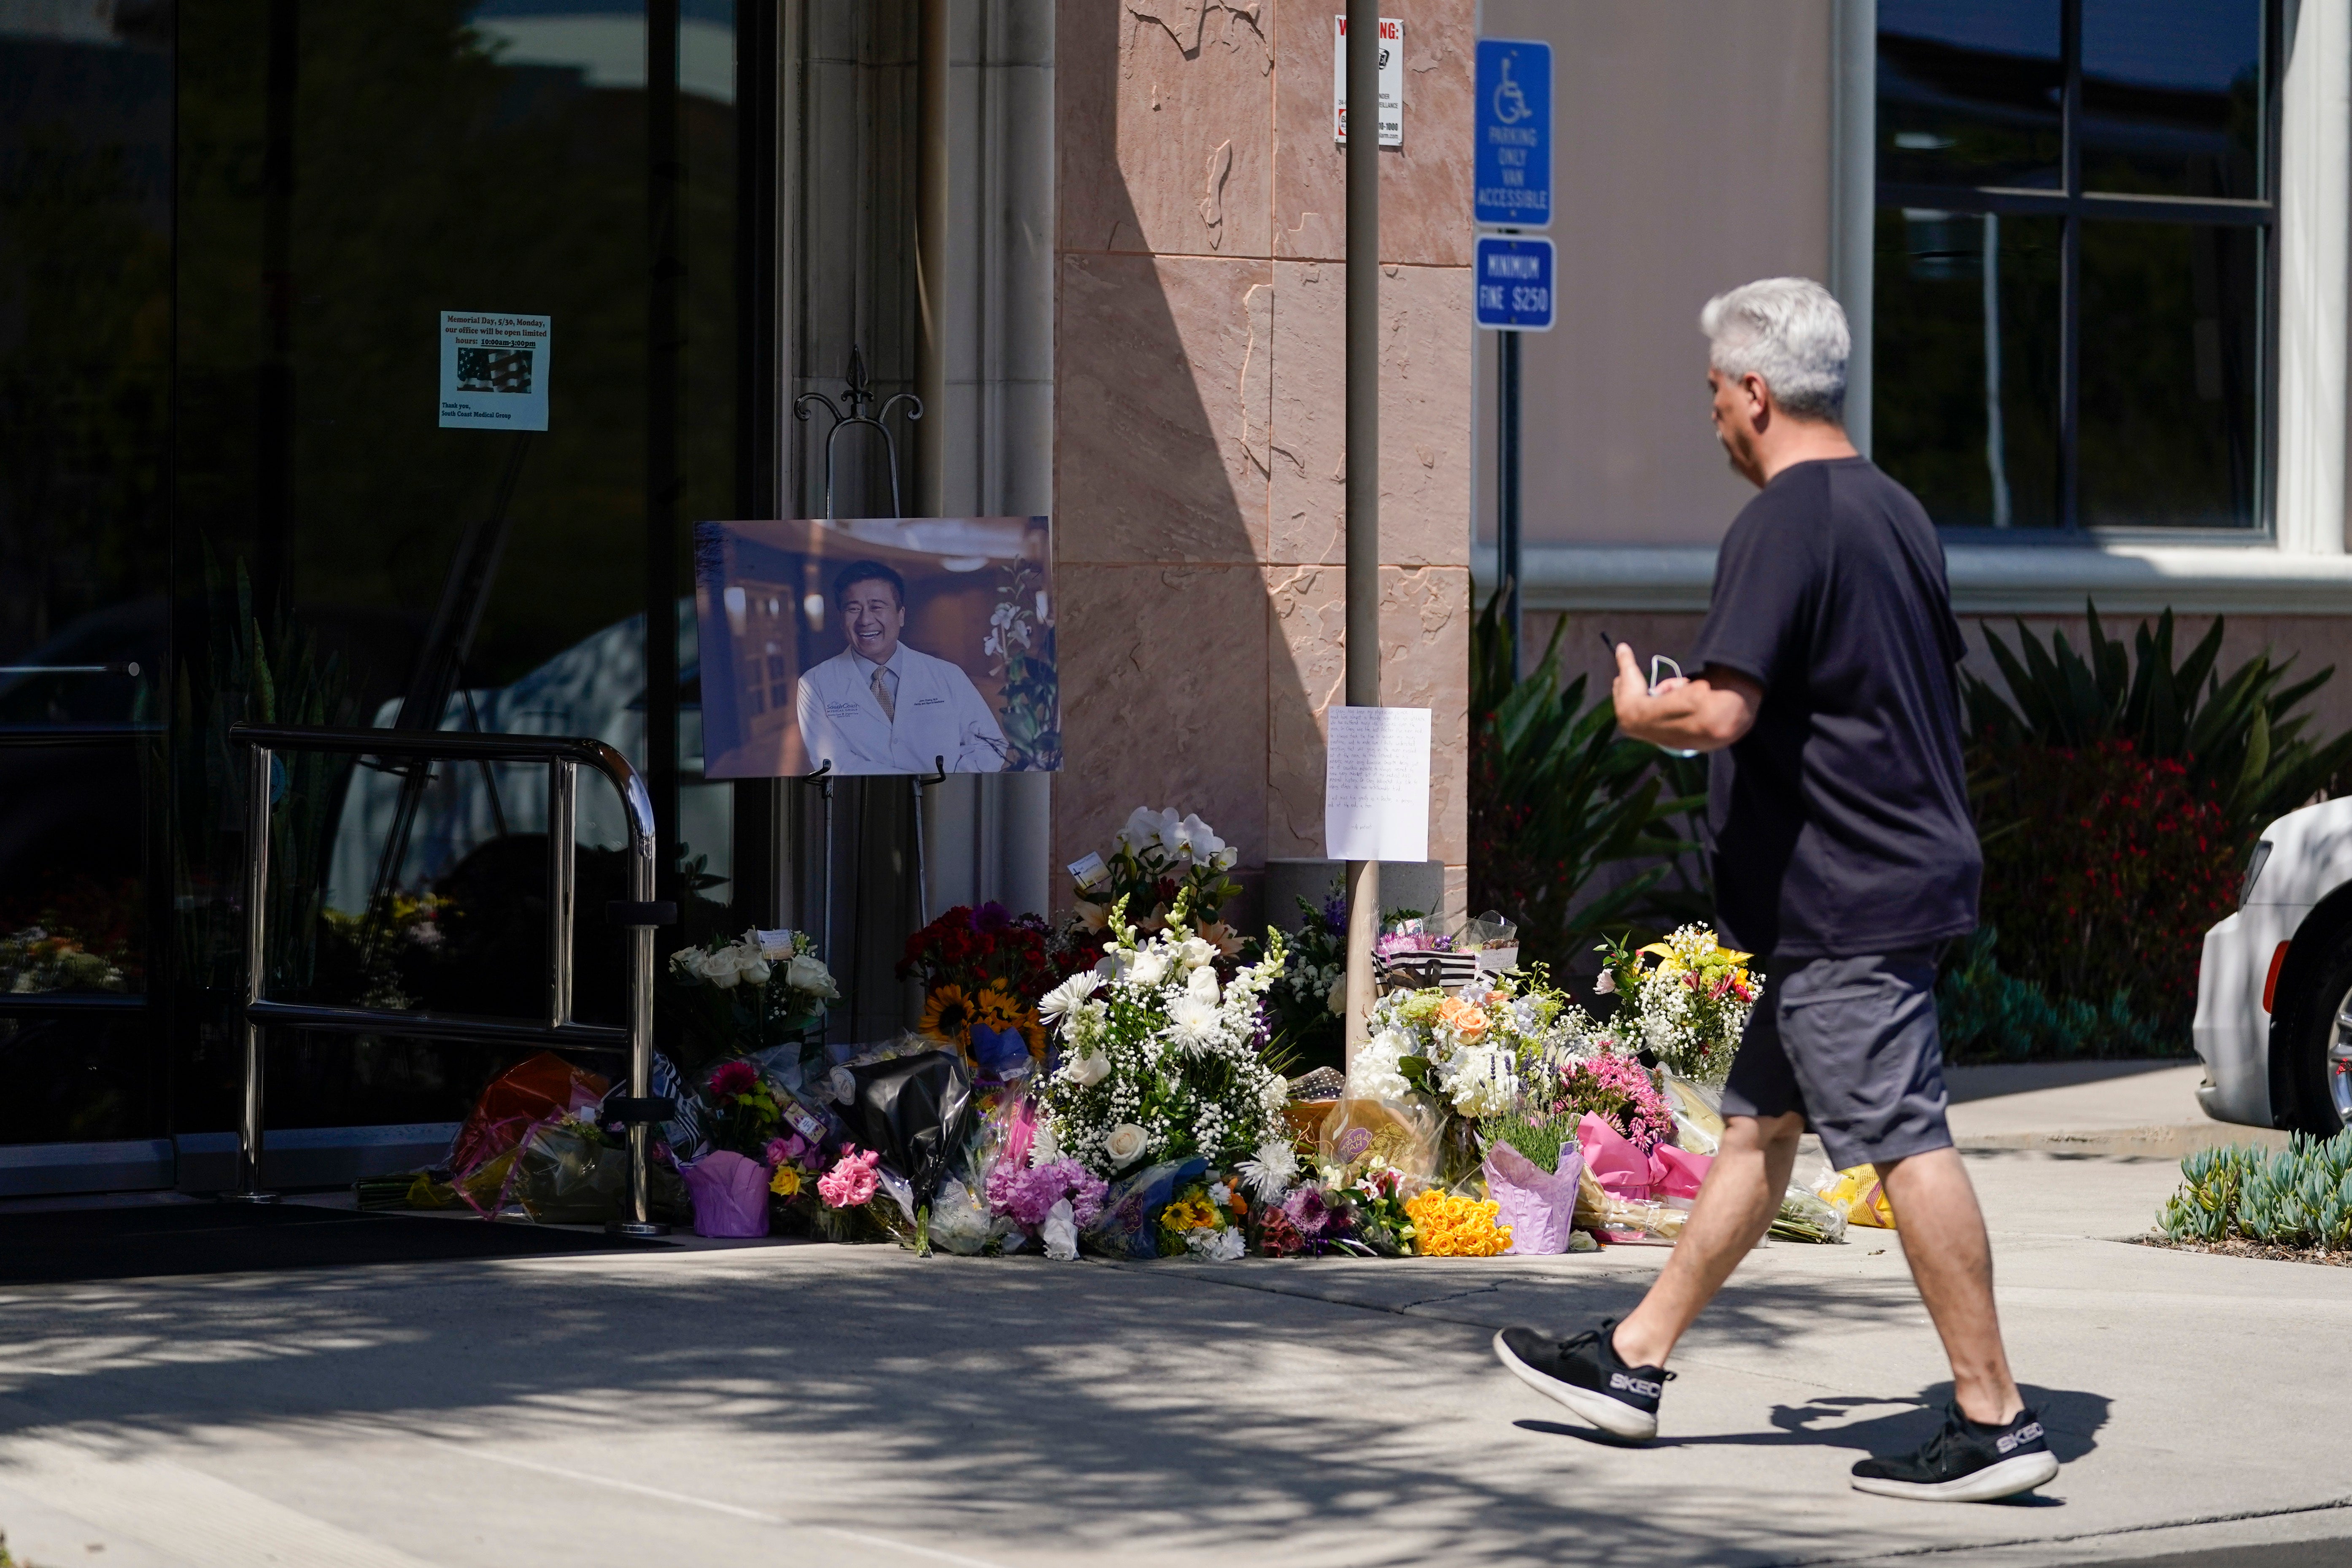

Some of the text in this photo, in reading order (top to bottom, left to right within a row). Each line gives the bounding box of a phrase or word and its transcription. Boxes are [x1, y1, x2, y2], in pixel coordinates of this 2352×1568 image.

[1498, 147, 1527, 166] ONLY
[1501, 168, 1524, 187] VAN
[1477, 187, 1549, 209] ACCESSIBLE
[1487, 254, 1540, 280] MINIMUM
[1479, 285, 1549, 313] FINE $250
[447, 315, 545, 328] Memorial Day, 5/30, Monday,
[459, 326, 478, 335] office
[495, 327, 503, 335] be
[481, 338, 536, 348] 10:00am-3:00pm
